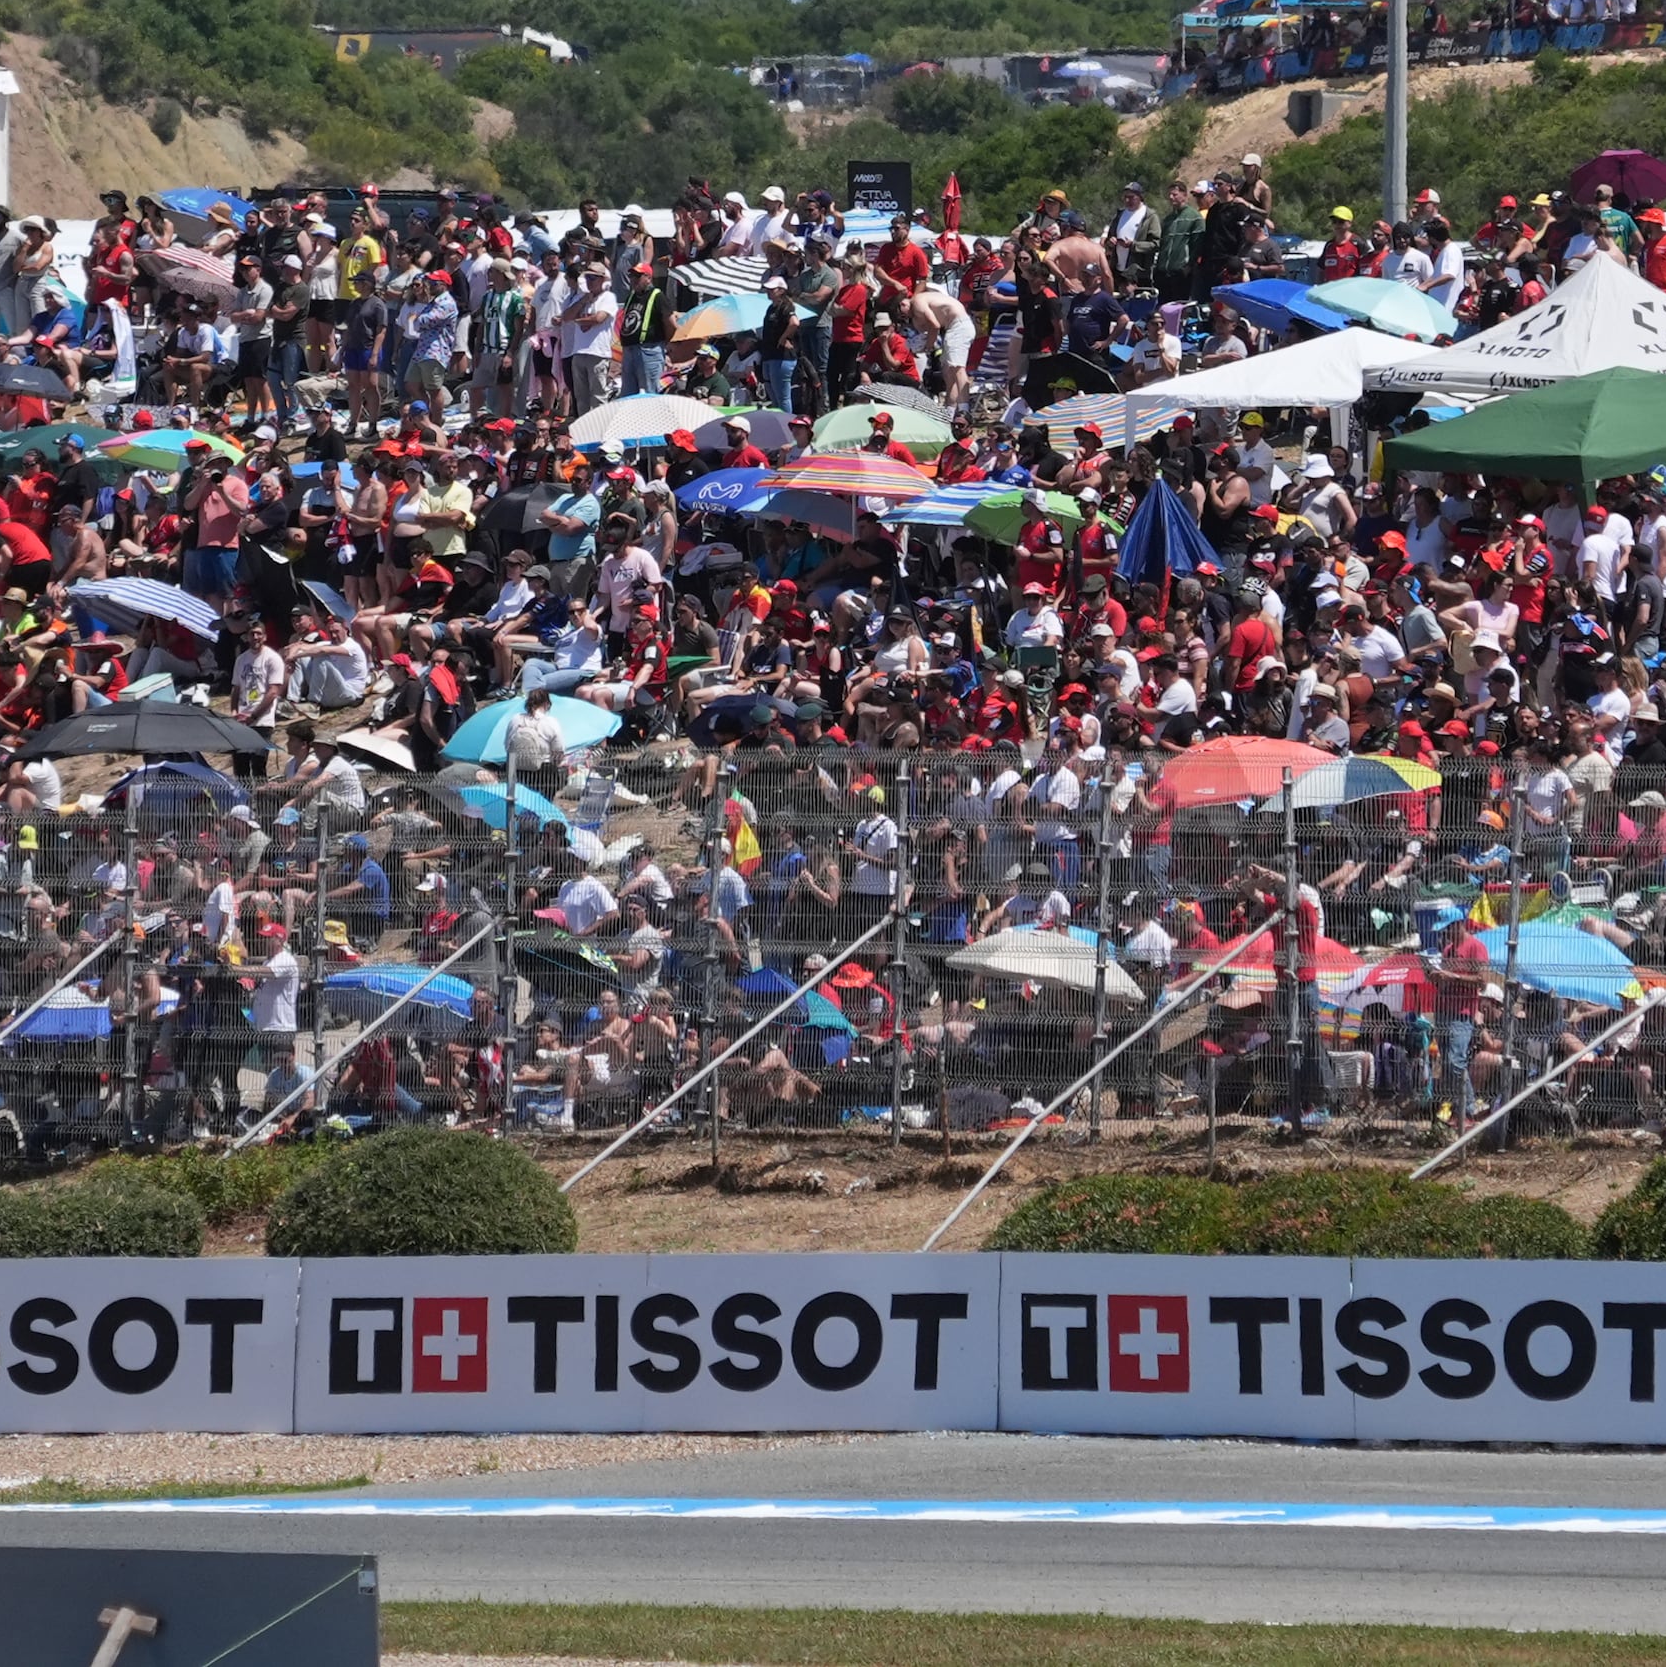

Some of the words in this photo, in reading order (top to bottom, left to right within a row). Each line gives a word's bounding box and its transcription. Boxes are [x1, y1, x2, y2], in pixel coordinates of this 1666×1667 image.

[854, 190, 892, 200] ACTIVA
[869, 201, 898, 210] MODO
[1395, 371, 1444, 383] XLMOTO
[507, 1290, 969, 1394] TISSOT
